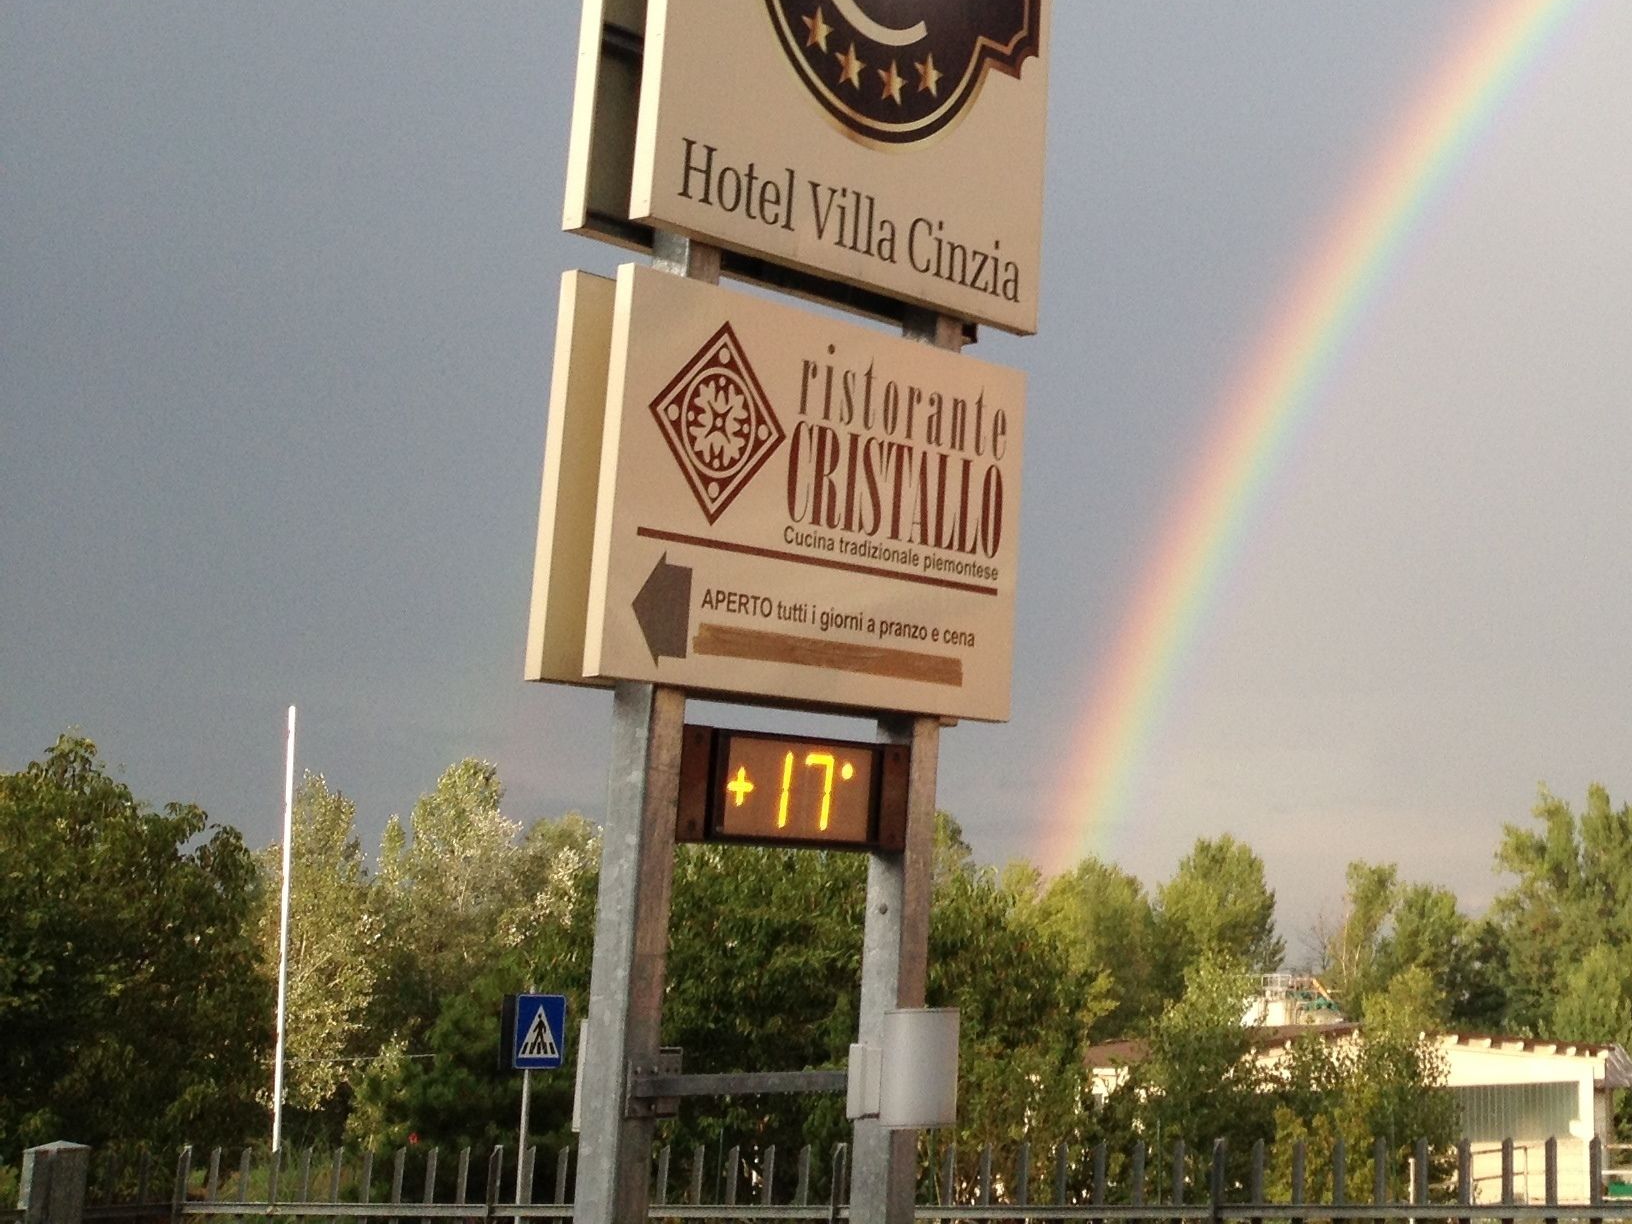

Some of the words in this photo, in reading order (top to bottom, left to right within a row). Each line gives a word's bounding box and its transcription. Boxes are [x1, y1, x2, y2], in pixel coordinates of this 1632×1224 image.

[677, 137, 796, 232] Hotel
[808, 180, 897, 264] Villa
[907, 217, 1020, 303] Cinzia
[798, 343, 1008, 461] ristorante
[787, 420, 1004, 559] CRISTALLO
[783, 525, 835, 552] Cucina
[839, 536, 920, 567] tradizionale
[923, 552, 999, 581] piemontese
[701, 588, 773, 618] APERTO
[777, 600, 807, 624] tutti
[811, 605, 816, 624] i
[820, 606, 864, 632] giorni
[867, 617, 876, 630] a
[879, 619, 928, 640] pranzo
[931, 628, 940, 642] e
[943, 627, 976, 648] cena
